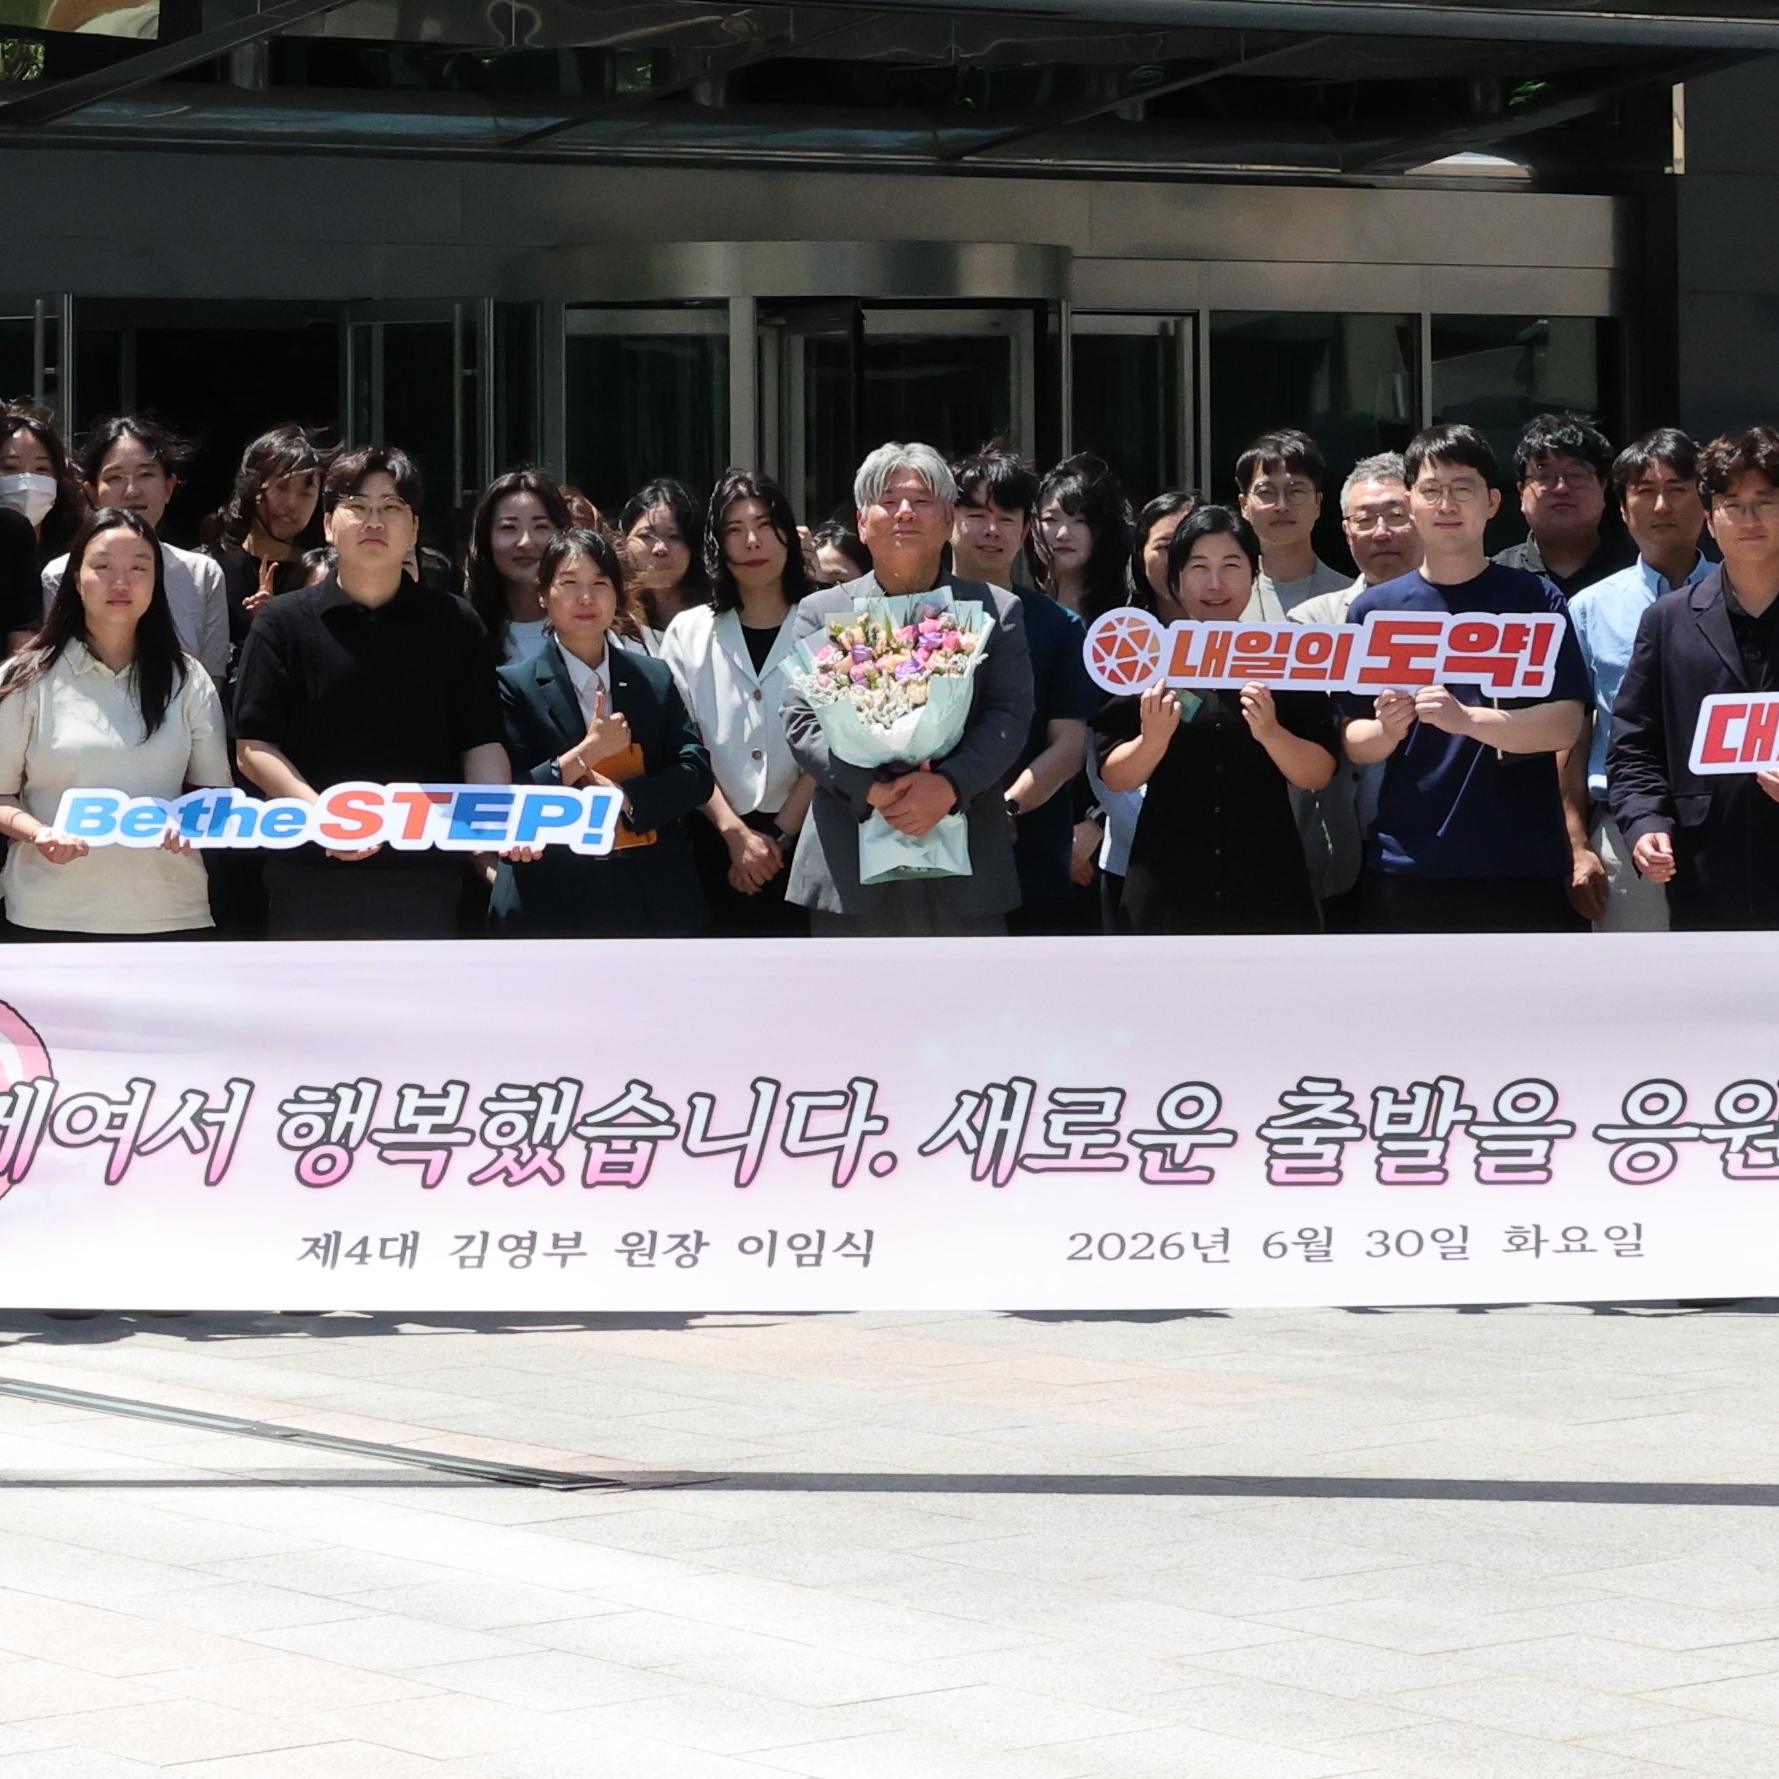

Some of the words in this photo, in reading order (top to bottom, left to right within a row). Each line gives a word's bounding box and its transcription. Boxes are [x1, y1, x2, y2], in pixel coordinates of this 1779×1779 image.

[1167, 629, 1355, 681] 내일의
[1357, 619, 1555, 687] 도약!
[319, 790, 613, 845] STEP!
[276, 1076, 899, 1188] 행복했습니다.
[917, 1076, 1237, 1187] 새로운
[1255, 1074, 1575, 1185] 출발을
[299, 1229, 419, 1270] 제4대
[448, 1229, 588, 1269] 김영부
[615, 1229, 711, 1269] 원장
[737, 1229, 876, 1268] 이임식
[1066, 1226, 1231, 1264] 2026년
[1261, 1226, 1336, 1263] 6월
[1363, 1224, 1472, 1261] 30일
[1502, 1223, 1646, 1260] 화요일
